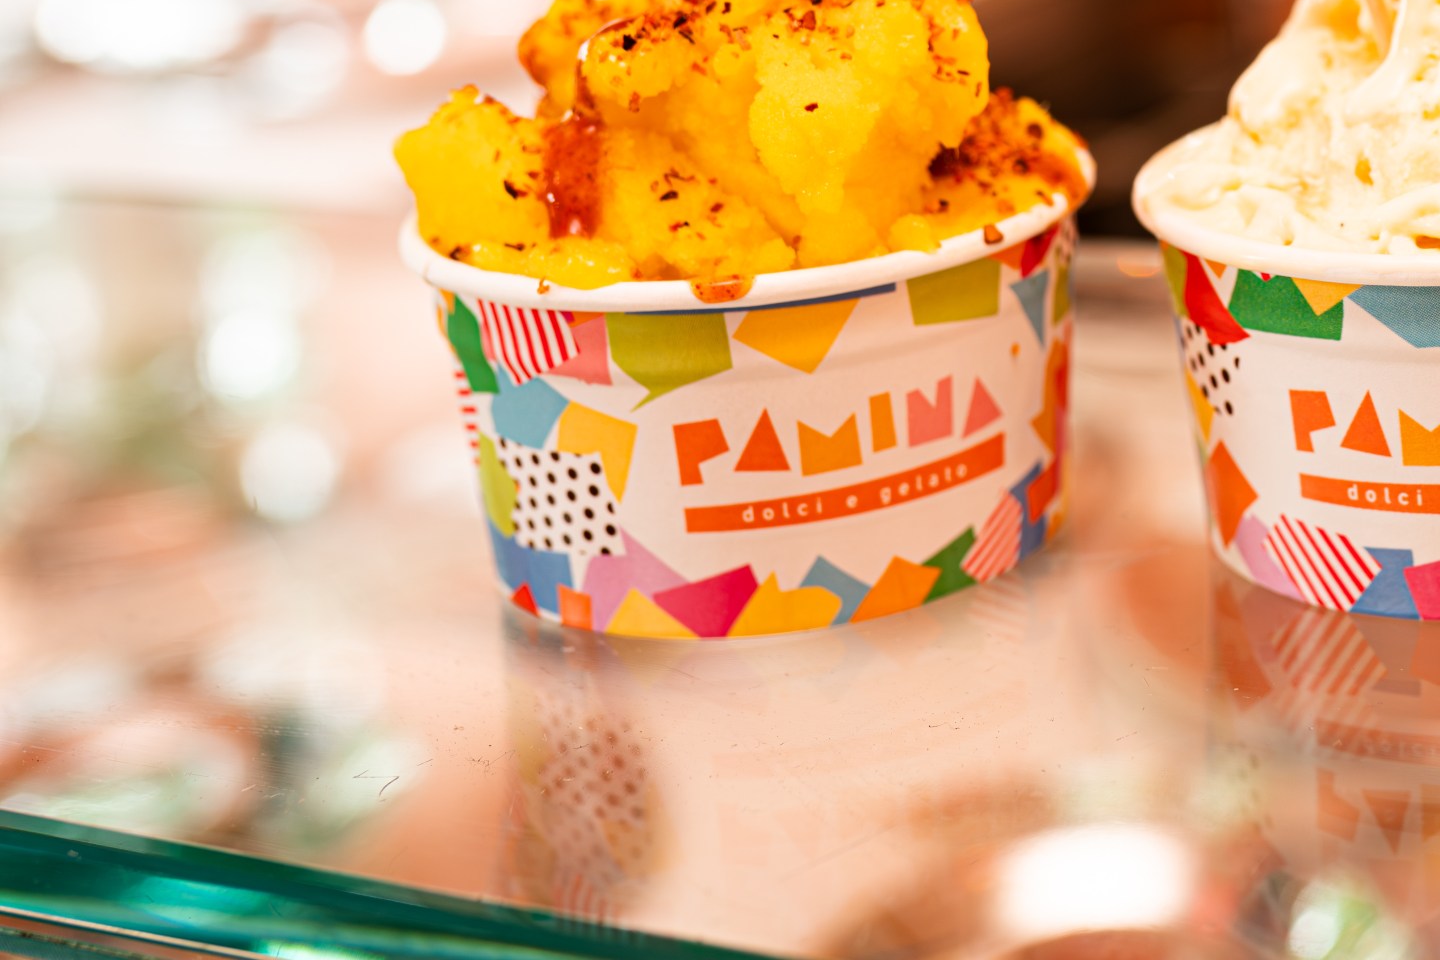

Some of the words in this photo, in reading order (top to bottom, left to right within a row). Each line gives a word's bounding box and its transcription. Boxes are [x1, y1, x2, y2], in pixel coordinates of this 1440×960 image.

[672, 374, 1004, 487] PAMINA
[741, 500, 823, 523] dolci
[845, 494, 858, 509] e
[879, 463, 968, 506] gelato
[1347, 483, 1423, 507] dolci
